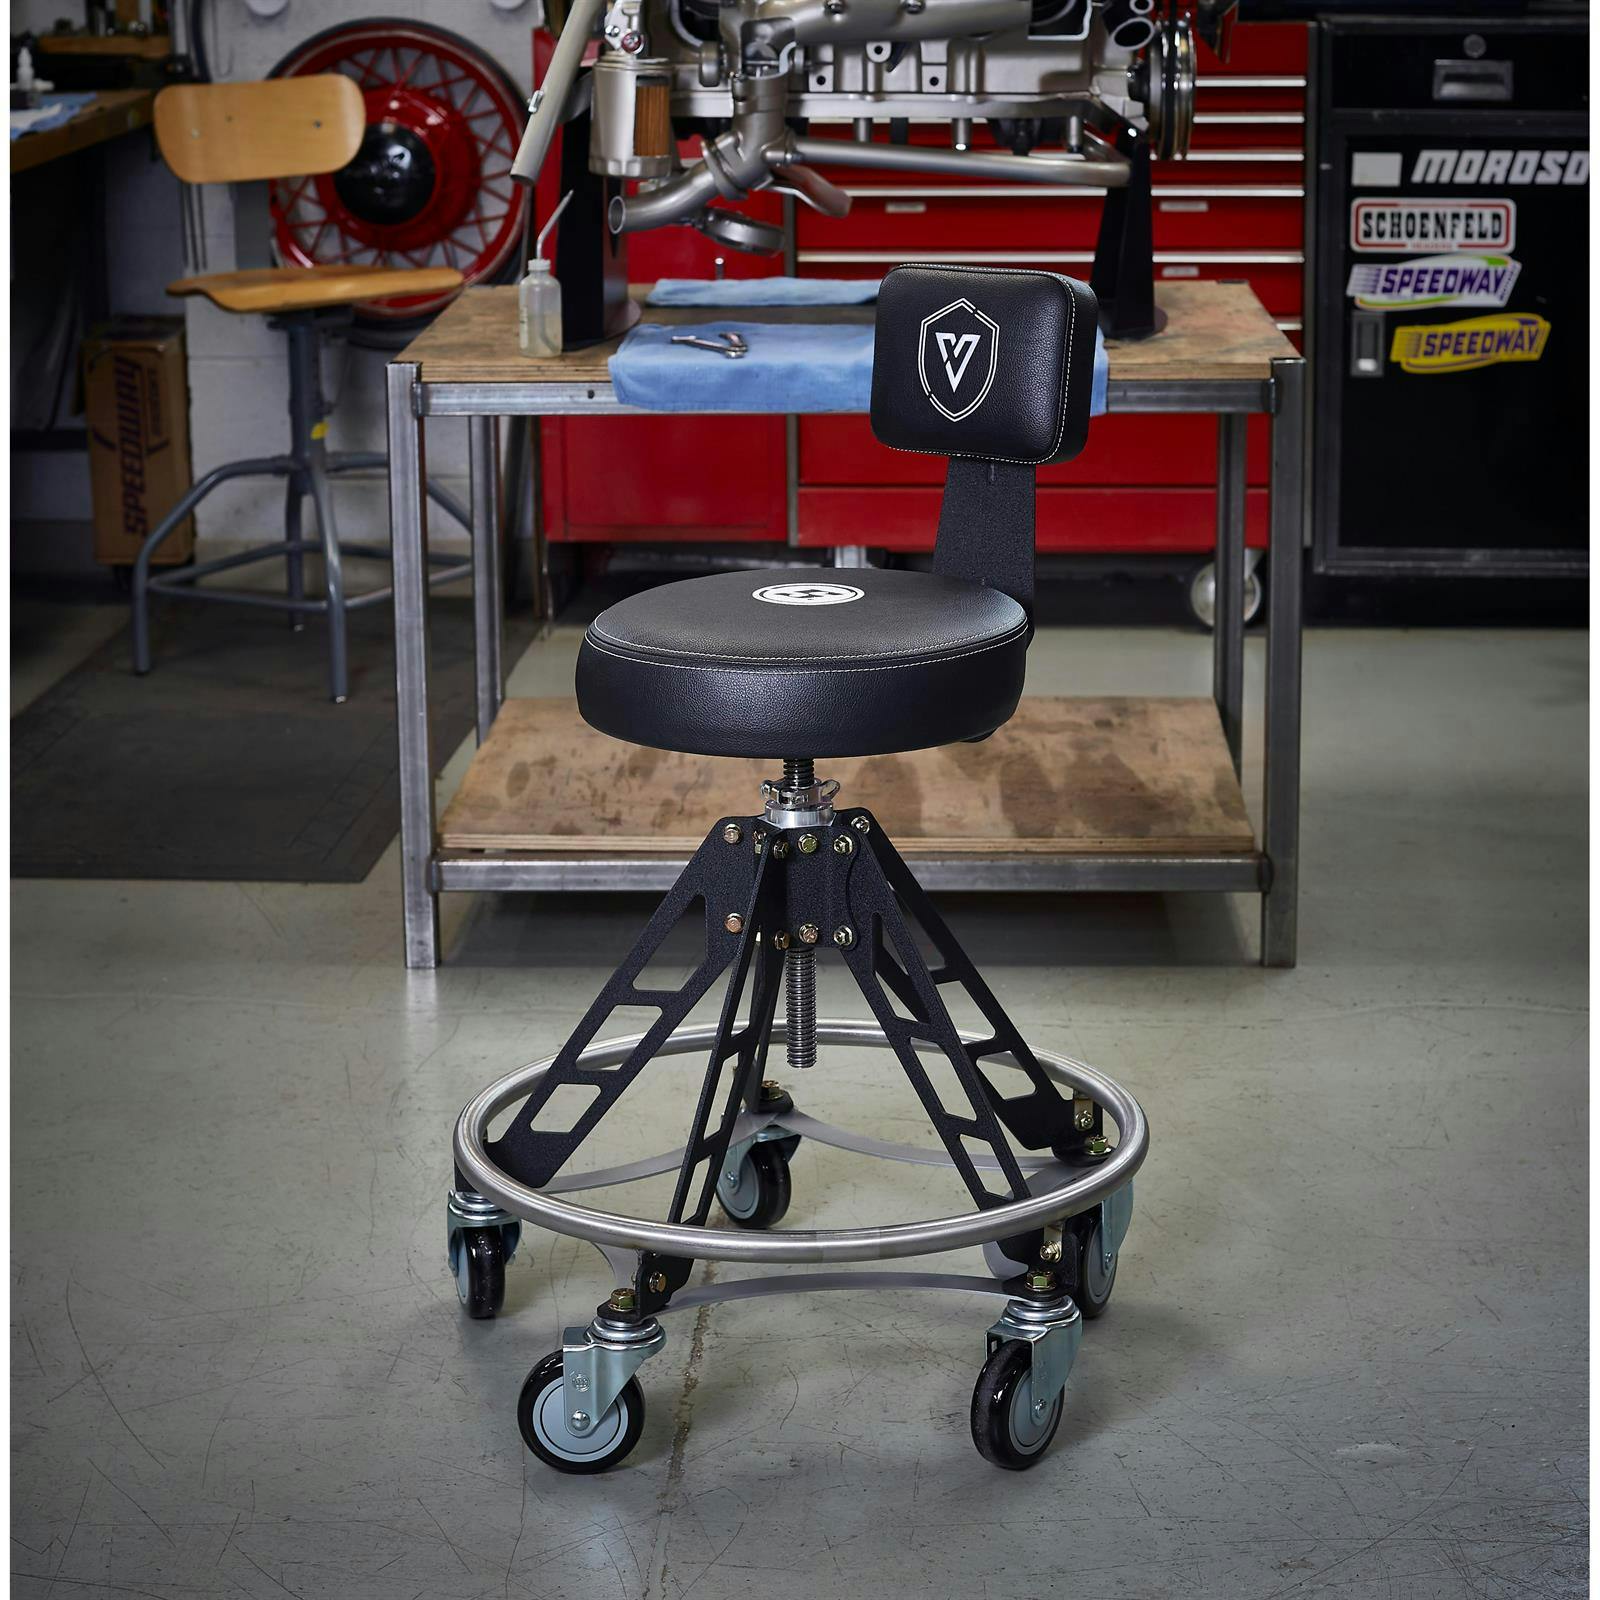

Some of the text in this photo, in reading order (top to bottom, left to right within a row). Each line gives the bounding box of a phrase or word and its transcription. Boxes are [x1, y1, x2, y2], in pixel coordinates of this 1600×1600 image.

[1363, 212, 1503, 238] SCHOENFELD
[1381, 268, 1506, 295] SPEEDWAY
[1423, 329, 1540, 356] SPEEDWAY
[114, 356, 148, 537] SPEEDWAY
